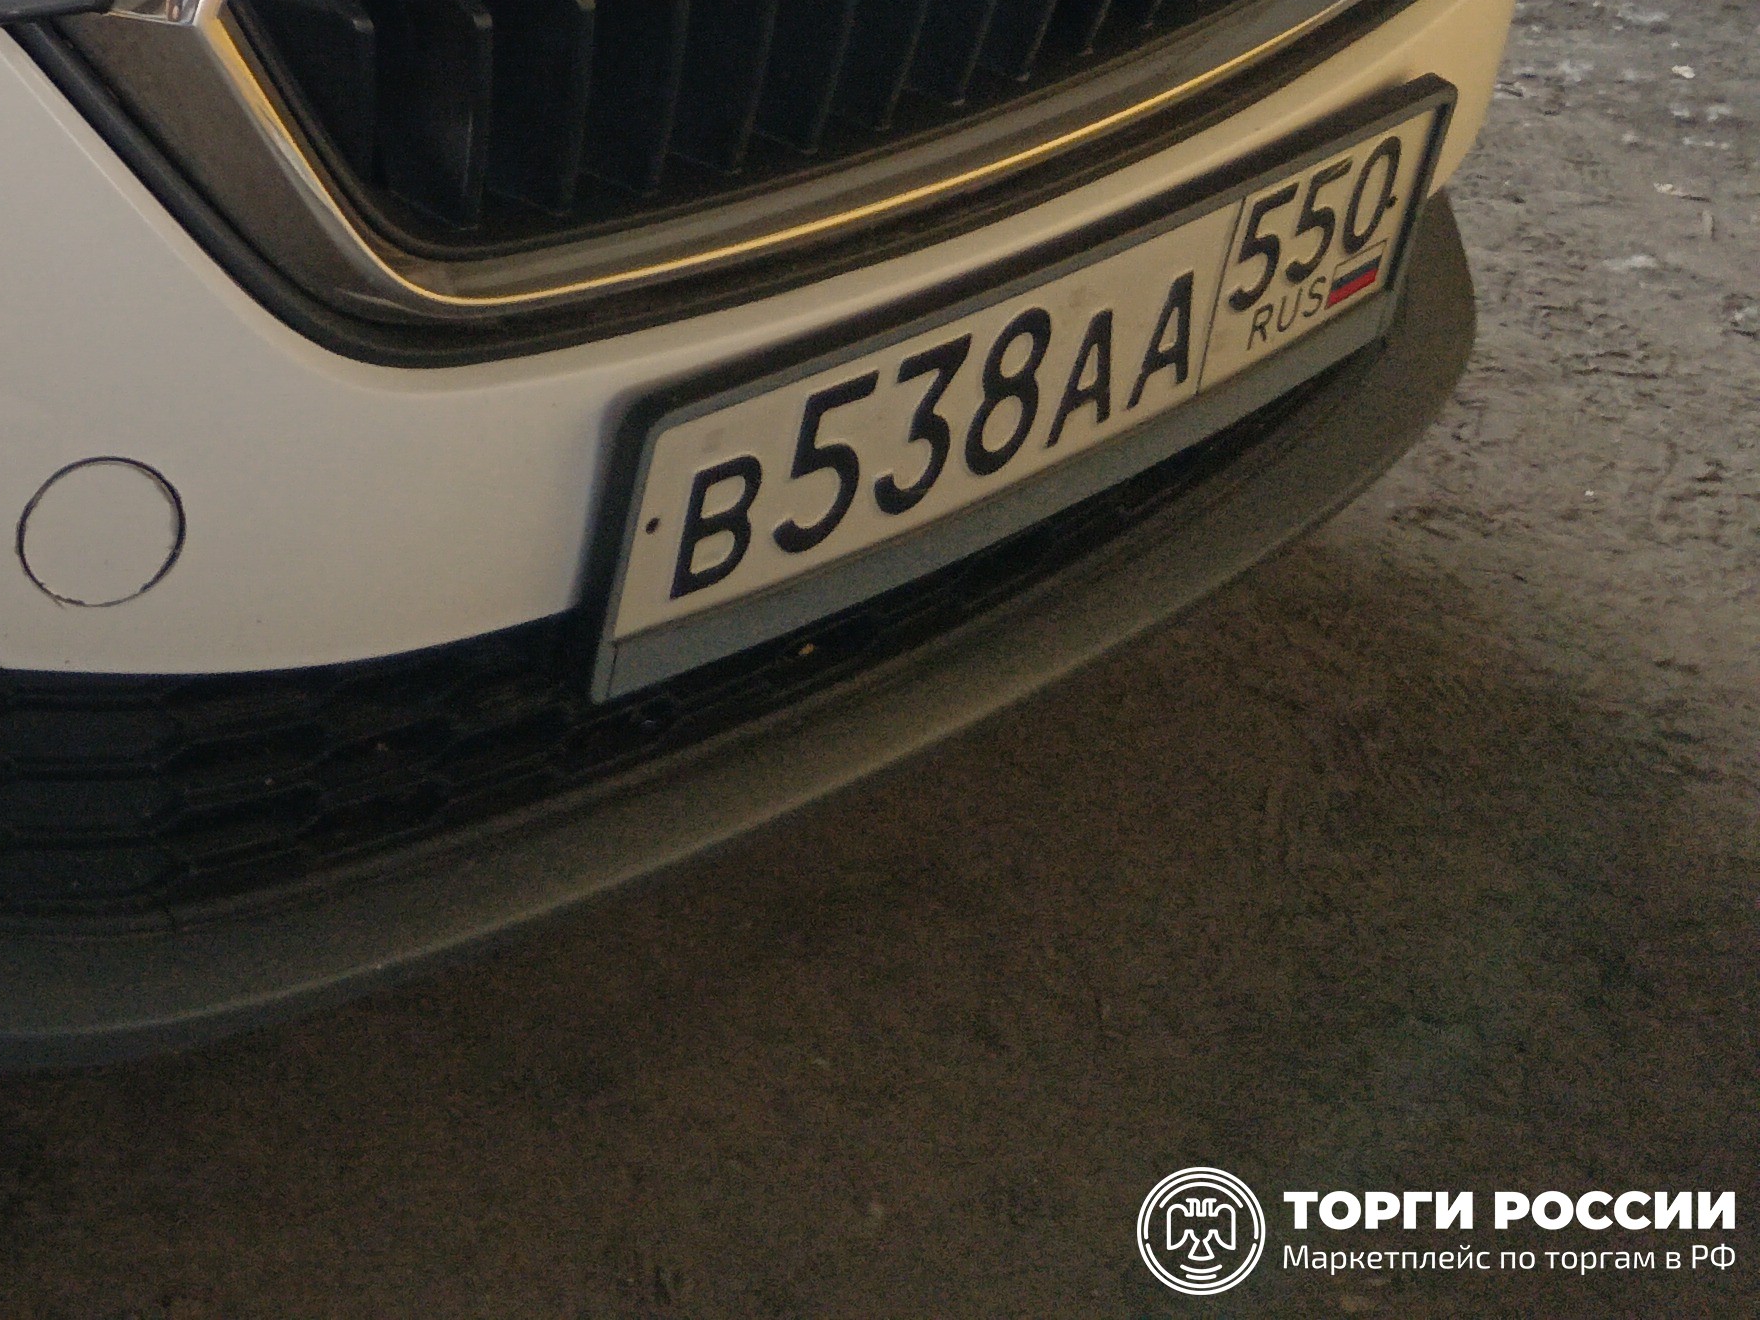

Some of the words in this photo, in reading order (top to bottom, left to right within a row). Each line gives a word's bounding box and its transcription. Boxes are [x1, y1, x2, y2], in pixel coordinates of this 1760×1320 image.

[669, 270, 1196, 600] В538АА
[1228, 135, 1402, 313] 550
[1247, 277, 1326, 351] RUS
